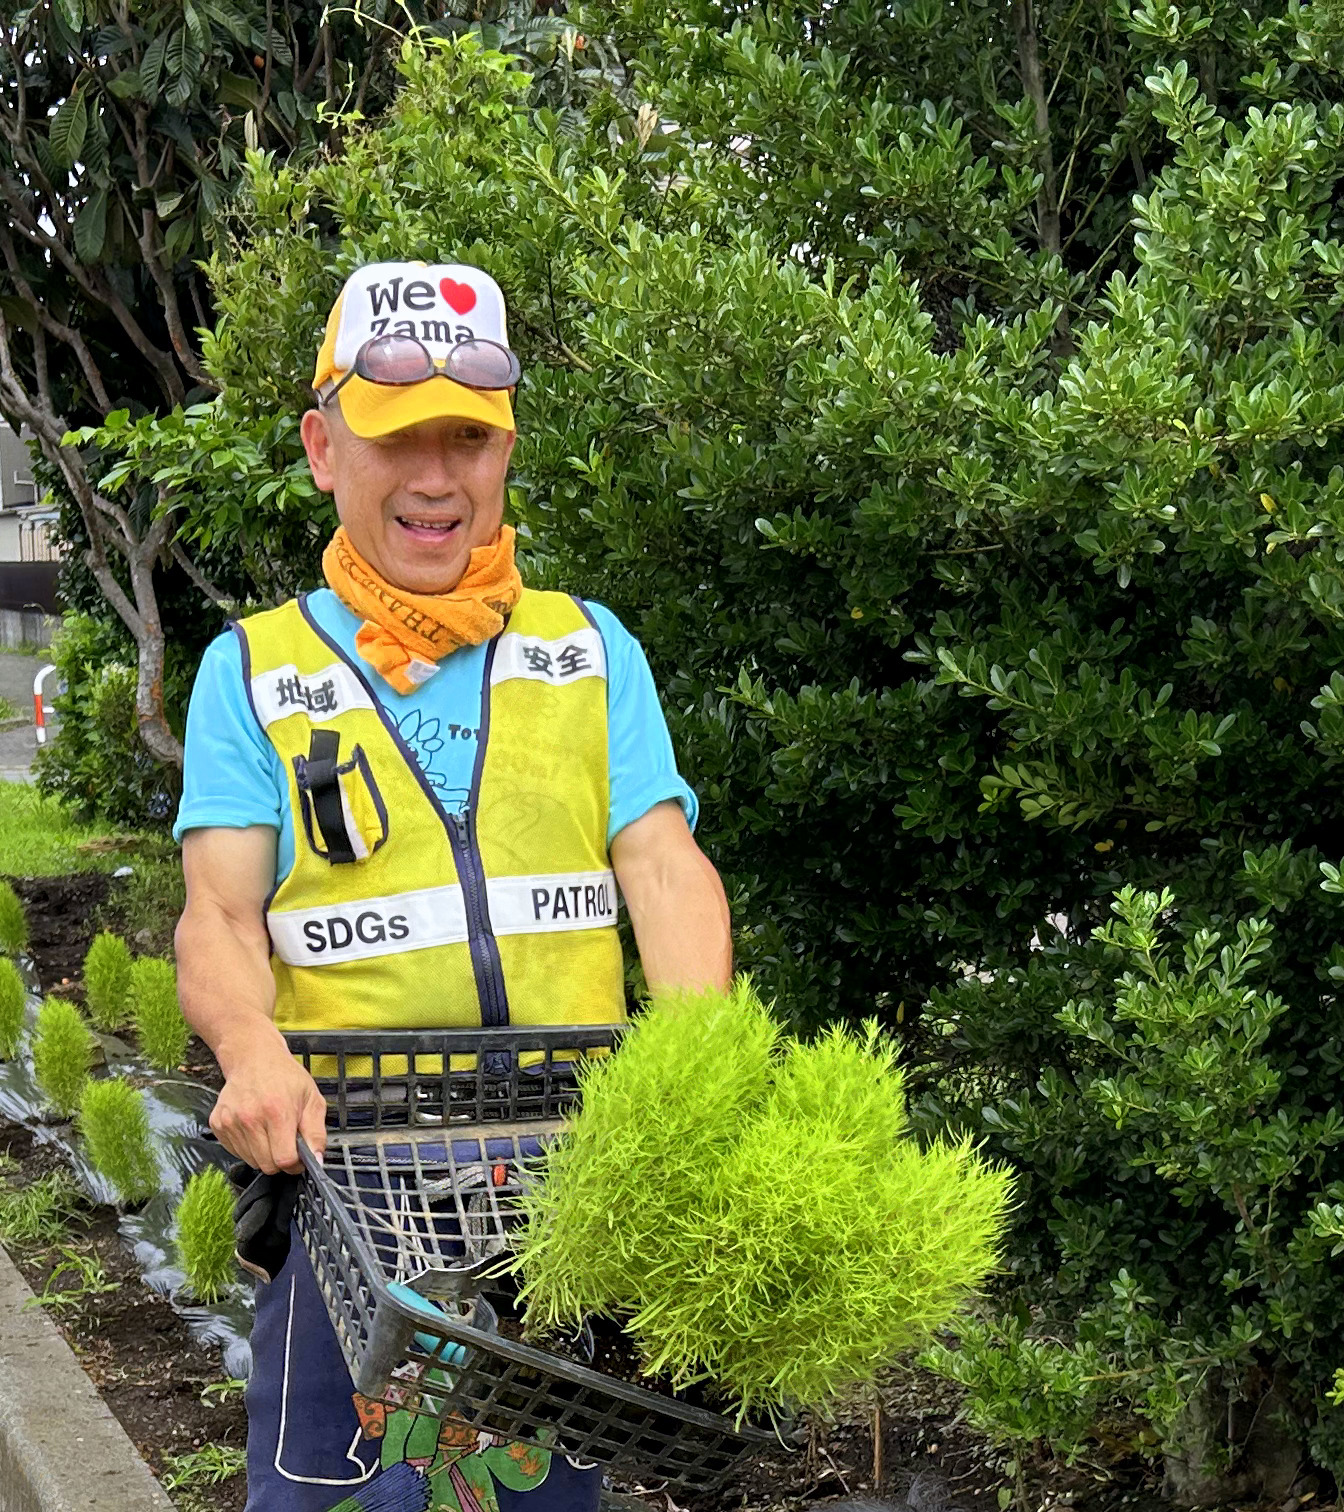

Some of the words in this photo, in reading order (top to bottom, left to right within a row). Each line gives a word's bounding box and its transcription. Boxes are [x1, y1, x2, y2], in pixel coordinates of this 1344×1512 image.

[523, 645, 592, 677] 安全
[276, 675, 338, 715] 地域
[532, 882, 613, 921] PATROL
[303, 911, 410, 953] SDGs
